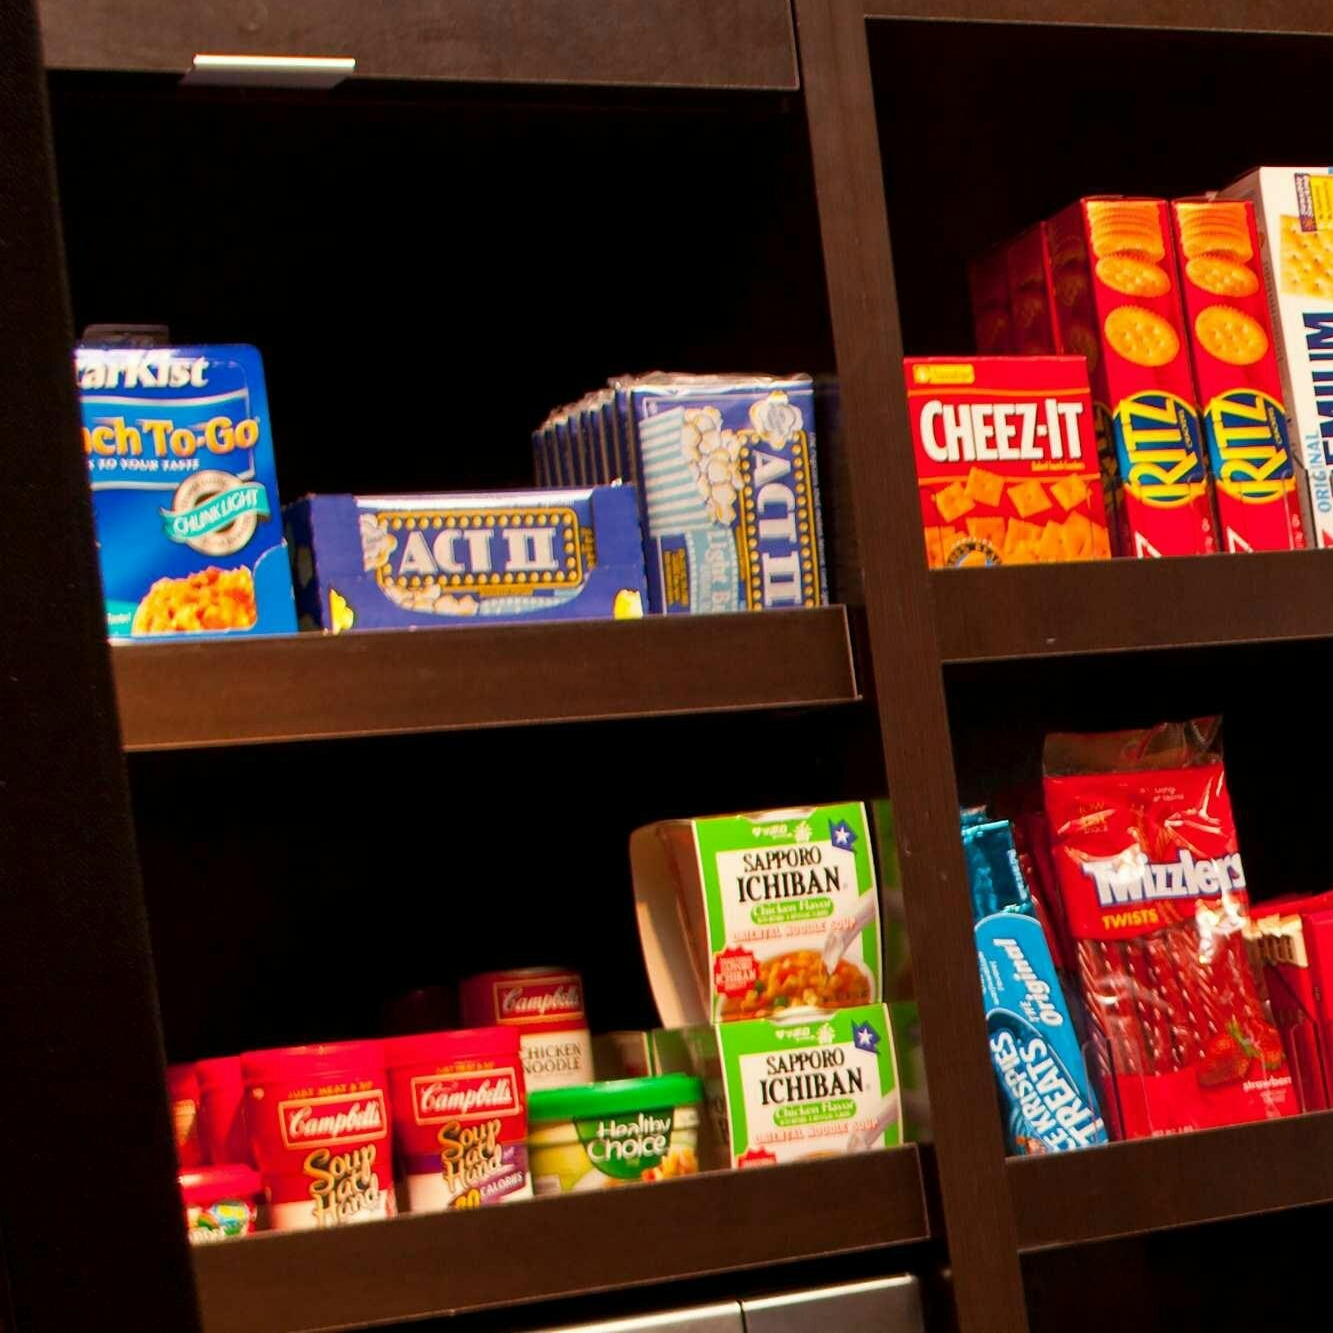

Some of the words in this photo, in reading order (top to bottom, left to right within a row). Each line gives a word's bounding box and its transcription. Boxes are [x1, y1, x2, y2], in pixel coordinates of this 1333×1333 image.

[77, 350, 210, 389] arKist
[137, 416, 260, 457] To-Go
[919, 398, 1084, 463] CHEEZ-IT
[1118, 396, 1204, 500] RITZ
[1207, 394, 1294, 497] RITZ
[1304, 430, 1332, 514] ORIGINAL
[221, 488, 260, 516] LIGHT
[751, 448, 798, 544] ACT
[399, 528, 495, 575] ACT
[502, 526, 560, 571] II
[743, 845, 822, 873] SAPPORO
[1081, 848, 1248, 908] Twizzlers
[736, 865, 841, 903] ICHIBAN
[1101, 908, 1159, 931] TWISTS
[766, 1047, 845, 1075] SAPPORO
[420, 1076, 514, 1113] Campbell's
[759, 1066, 864, 1105] ICHIBAN
[989, 1030, 1052, 1136] KRISPIES
[1019, 1036, 1105, 1149] TREATS
[288, 1100, 382, 1138] Campbell's
[437, 1118, 502, 1156] Soup
[599, 1112, 671, 1140] Healthy
[587, 1131, 670, 1163] Choice
[303, 1143, 377, 1194] Soup
[336, 1172, 367, 1198] at
[441, 1143, 505, 1193] Hand
[312, 1173, 381, 1229] Hand
